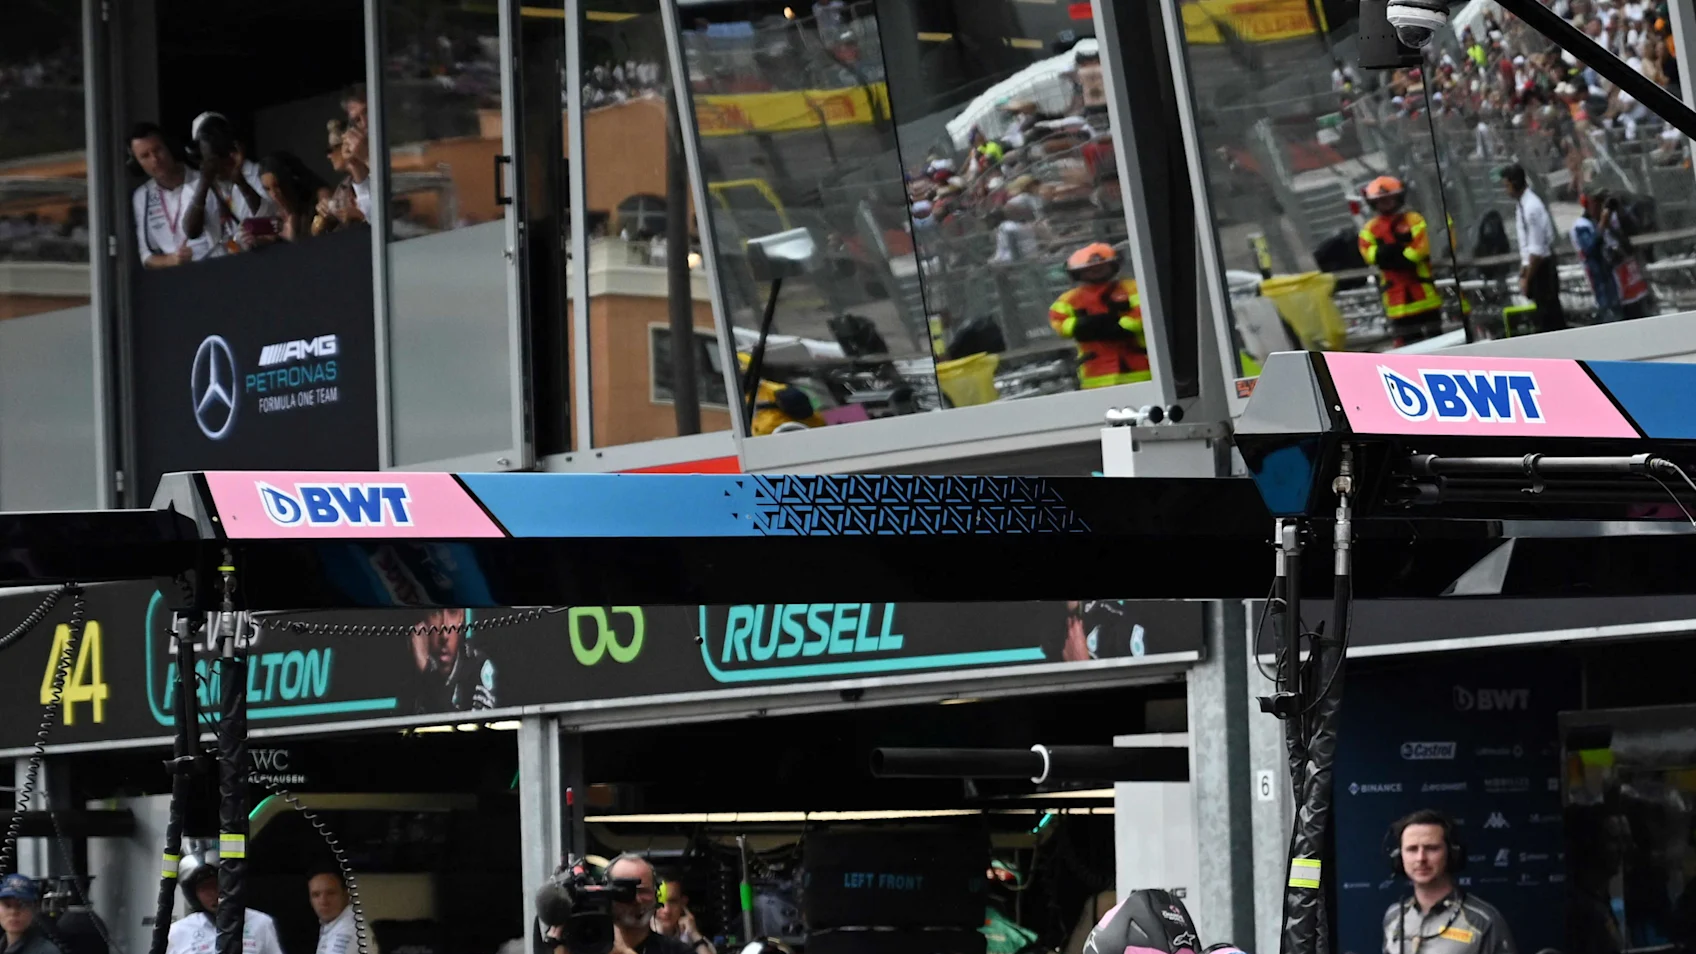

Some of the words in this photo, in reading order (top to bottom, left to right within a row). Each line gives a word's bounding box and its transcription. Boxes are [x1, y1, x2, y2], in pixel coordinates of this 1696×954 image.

[281, 334, 337, 361] AMG
[246, 361, 337, 392] PETRONAS
[259, 393, 296, 413] FORMULA
[297, 391, 314, 407] ONE
[315, 387, 337, 404] TEAM
[1427, 371, 1543, 421] BWT
[296, 484, 411, 526] BWT
[721, 603, 905, 662] RUSSELL
[40, 620, 108, 725] 44
[1477, 688, 1531, 711] BWT
[1260, 774, 1271, 796] 6
[1360, 782, 1402, 794] BINANCE
[844, 872, 874, 889] LEFT
[879, 873, 924, 891] FRONT
